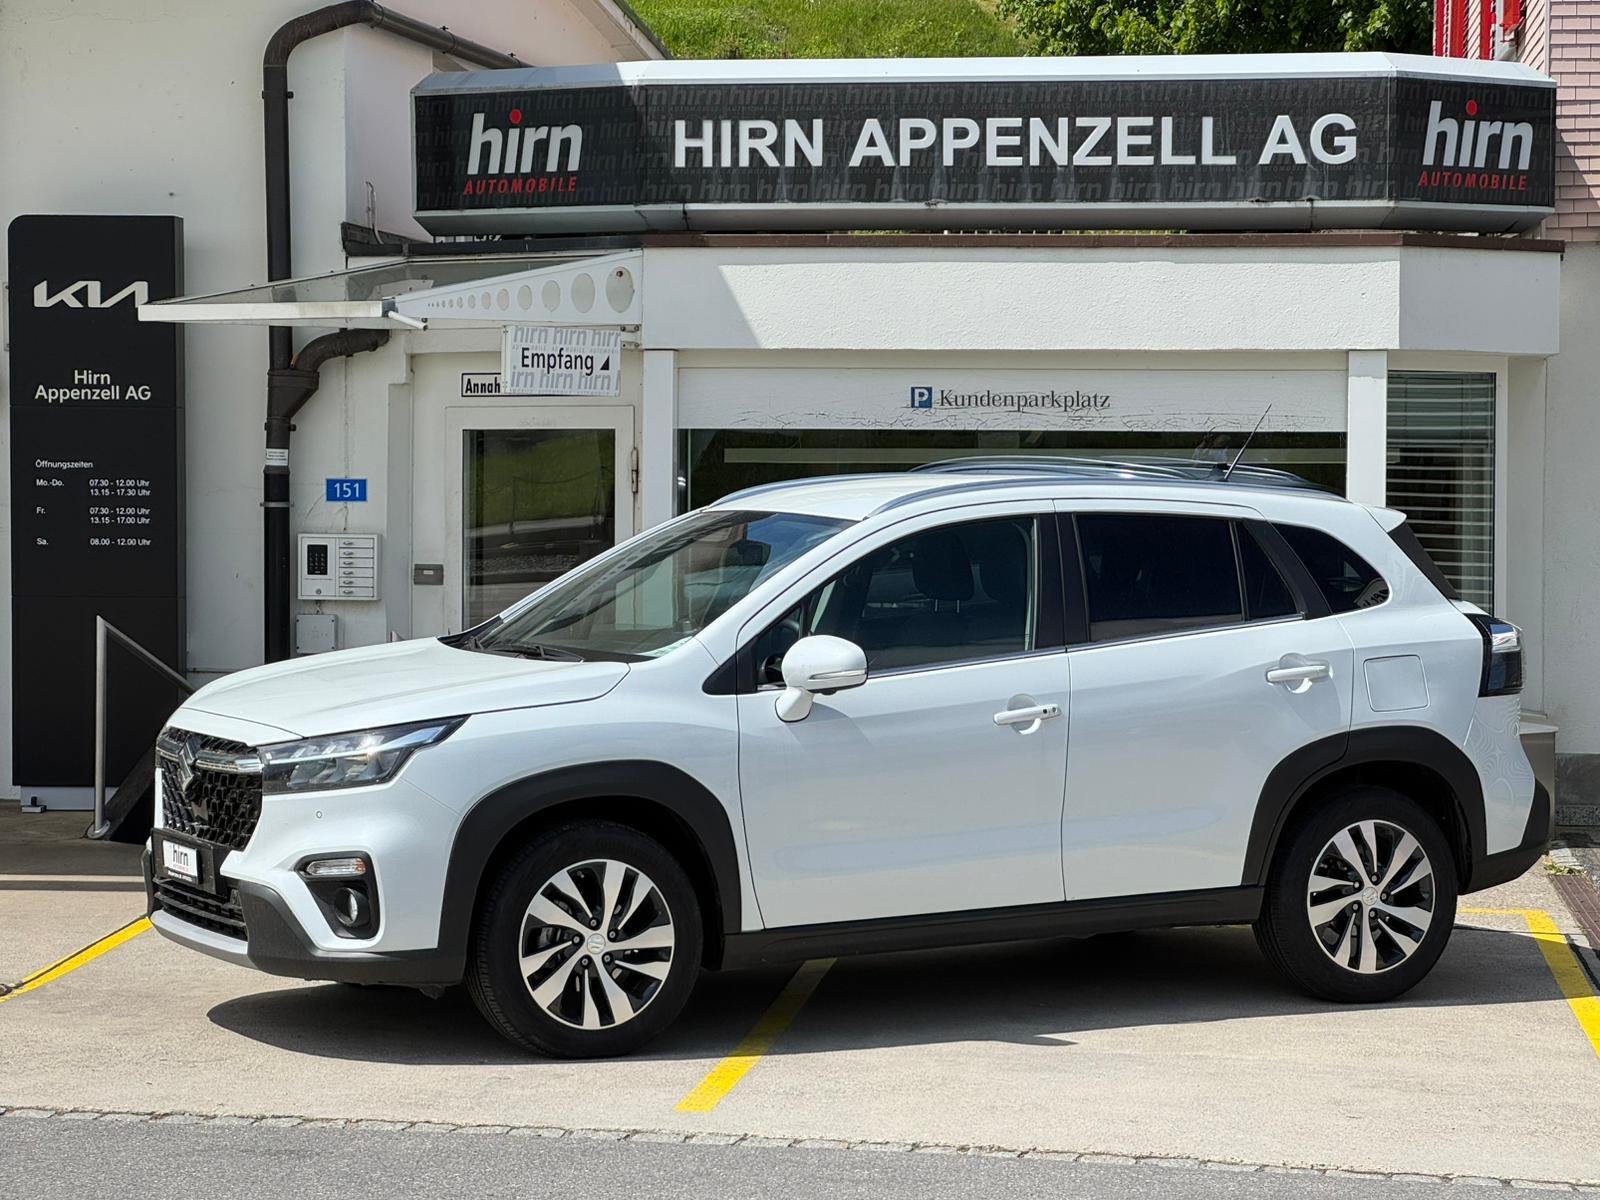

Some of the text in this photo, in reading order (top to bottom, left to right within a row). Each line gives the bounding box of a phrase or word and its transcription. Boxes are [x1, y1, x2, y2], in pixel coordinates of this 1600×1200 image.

[466, 108, 583, 175] hirn
[674, 113, 1358, 168] HIRN APPENZELL AG
[1422, 99, 1534, 170] hirn
[463, 176, 577, 195] AUTOMOBILE
[1418, 171, 1527, 191] AUTOMOBILE
[521, 347, 594, 376] Empfang
[74, 370, 111, 385] Hirn
[465, 377, 500, 394] Annah
[35, 385, 151, 403] Appenzell AG
[939, 389, 1111, 412] Kundenparkplatz
[35, 458, 94, 470] Öffnungszeiten
[89, 479, 109, 487] 07.30
[116, 479, 135, 487] 12.00
[137, 479, 150, 487] Uhr
[334, 482, 360, 498] 151
[90, 488, 110, 496] 13.15
[117, 488, 136, 496] 17.30
[138, 488, 151, 496] Uhr
[89, 507, 110, 515] 07.30
[116, 507, 135, 515] 12.00
[137, 507, 150, 515] Uhr
[90, 516, 111, 525] 13.15
[117, 516, 135, 525] 17.00
[137, 516, 151, 525] Uhr
[36, 537, 49, 546] Sa.
[89, 538, 111, 546] 08.00
[117, 538, 136, 546] 12.00
[138, 538, 151, 546] Uhr
[172, 844, 189, 867] hirn
